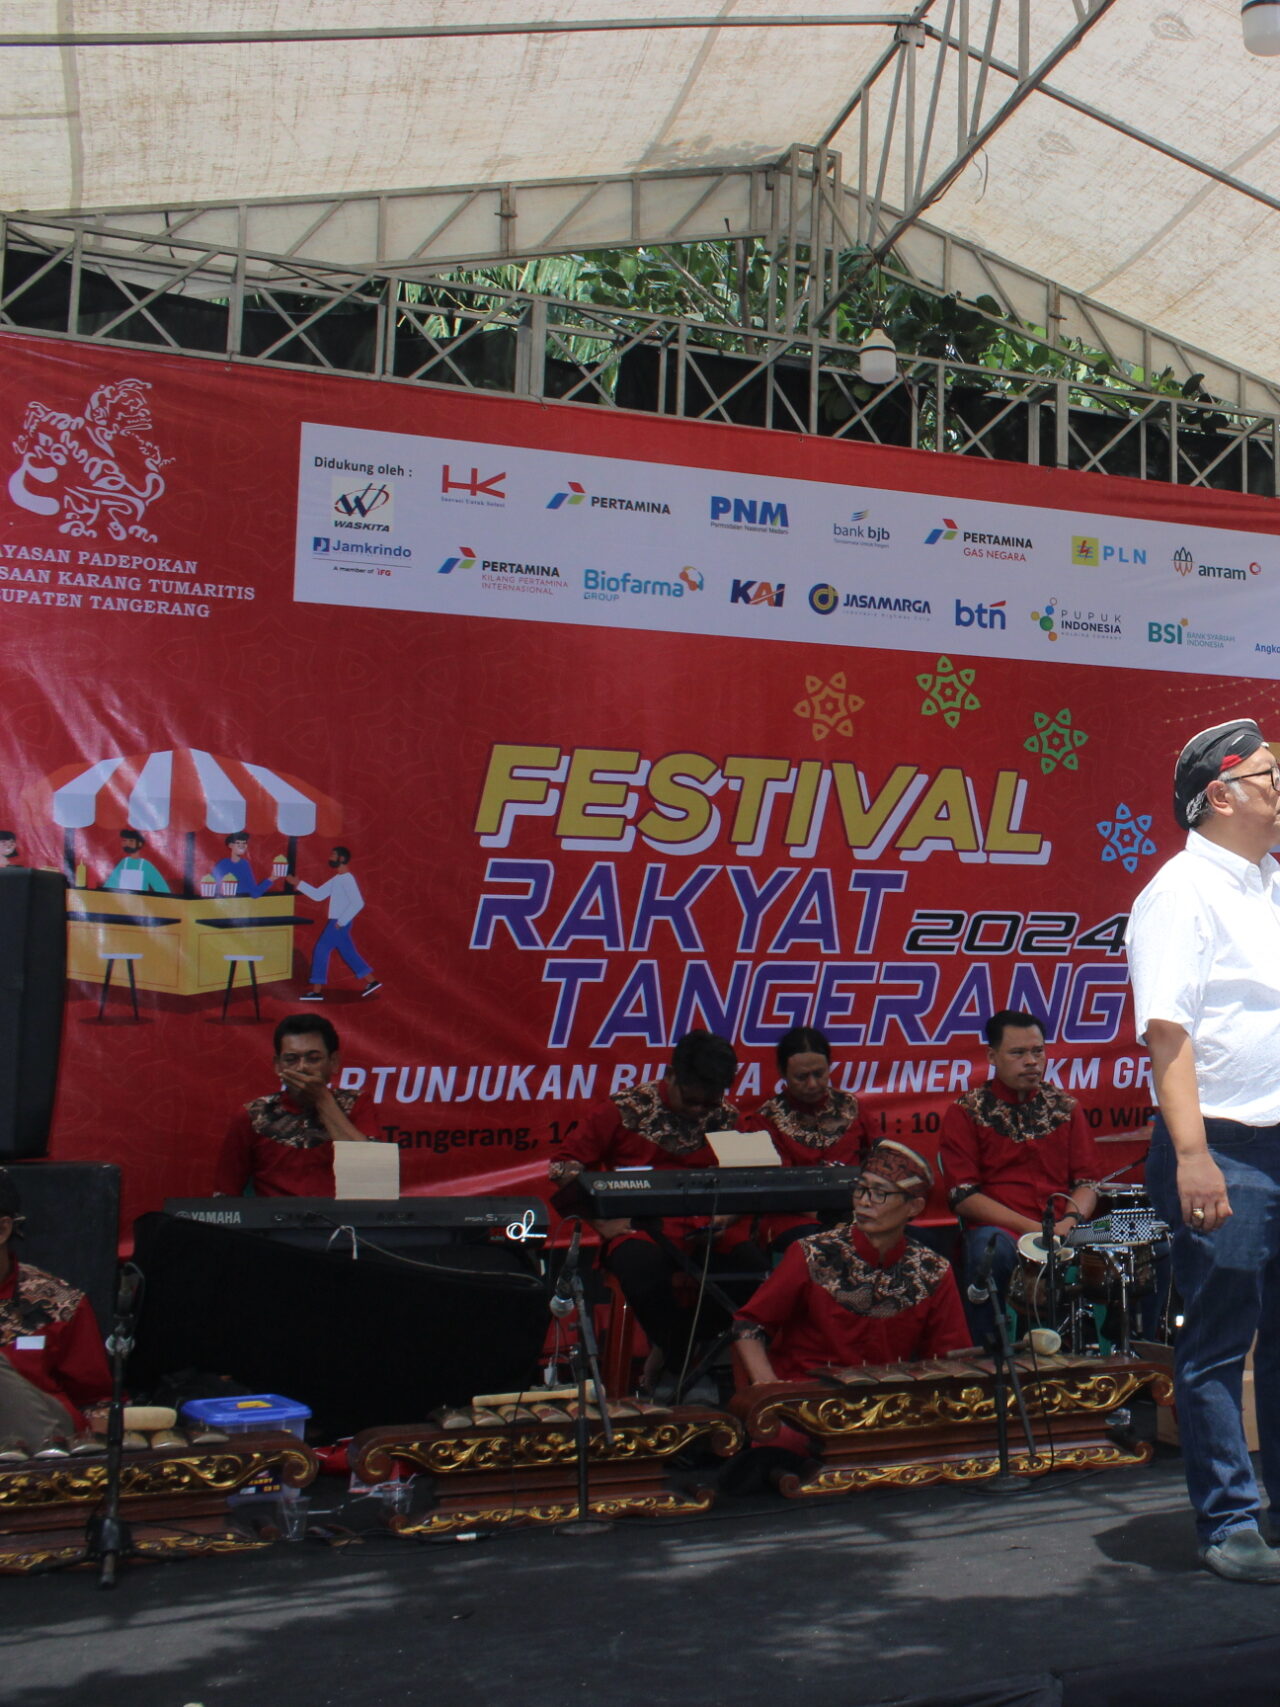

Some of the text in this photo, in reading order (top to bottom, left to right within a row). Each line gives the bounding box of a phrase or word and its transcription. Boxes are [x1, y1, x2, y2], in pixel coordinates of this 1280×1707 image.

[314, 456, 374, 476] Didukung
[378, 464, 405, 477] oleh
[441, 464, 506, 499] HK
[591, 496, 671, 515] PERTAMINA
[710, 496, 789, 527] PNM
[333, 520, 390, 533] WASKITA
[833, 523, 890, 542] bank bjb
[332, 540, 412, 558] Jamkrindo
[963, 532, 1033, 549] PERTAMINA
[78, 551, 198, 574] PADEPOKAN
[963, 547, 1026, 562] GAS NEGARA
[1103, 545, 1147, 565] PLN
[482, 560, 560, 577] PERTAMINA
[58, 571, 141, 591] KARANG
[148, 579, 255, 601] TUMARITIS
[481, 575, 568, 588] KILANG PERTAMINA
[481, 582, 553, 595] INTERNASIONAL
[584, 568, 684, 598] Biofarma
[0, 588, 210, 617] UPATEN TANGERANG
[584, 592, 619, 602] GROUP
[730, 579, 785, 607] KAI
[955, 598, 1006, 630] btn
[1061, 609, 1121, 622] PUPUK
[1061, 620, 1121, 634] INDONESIA
[1148, 622, 1182, 645] BSI
[1187, 640, 1224, 648] INDONESIA
[474, 744, 1050, 864] FESTIVAL
[469, 858, 1131, 957] RAKYAT 2024
[541, 958, 1132, 1049] TANGERANG
[607, 1179, 651, 1189] YAMAHA
[191, 1212, 241, 1224] YAMAHA
